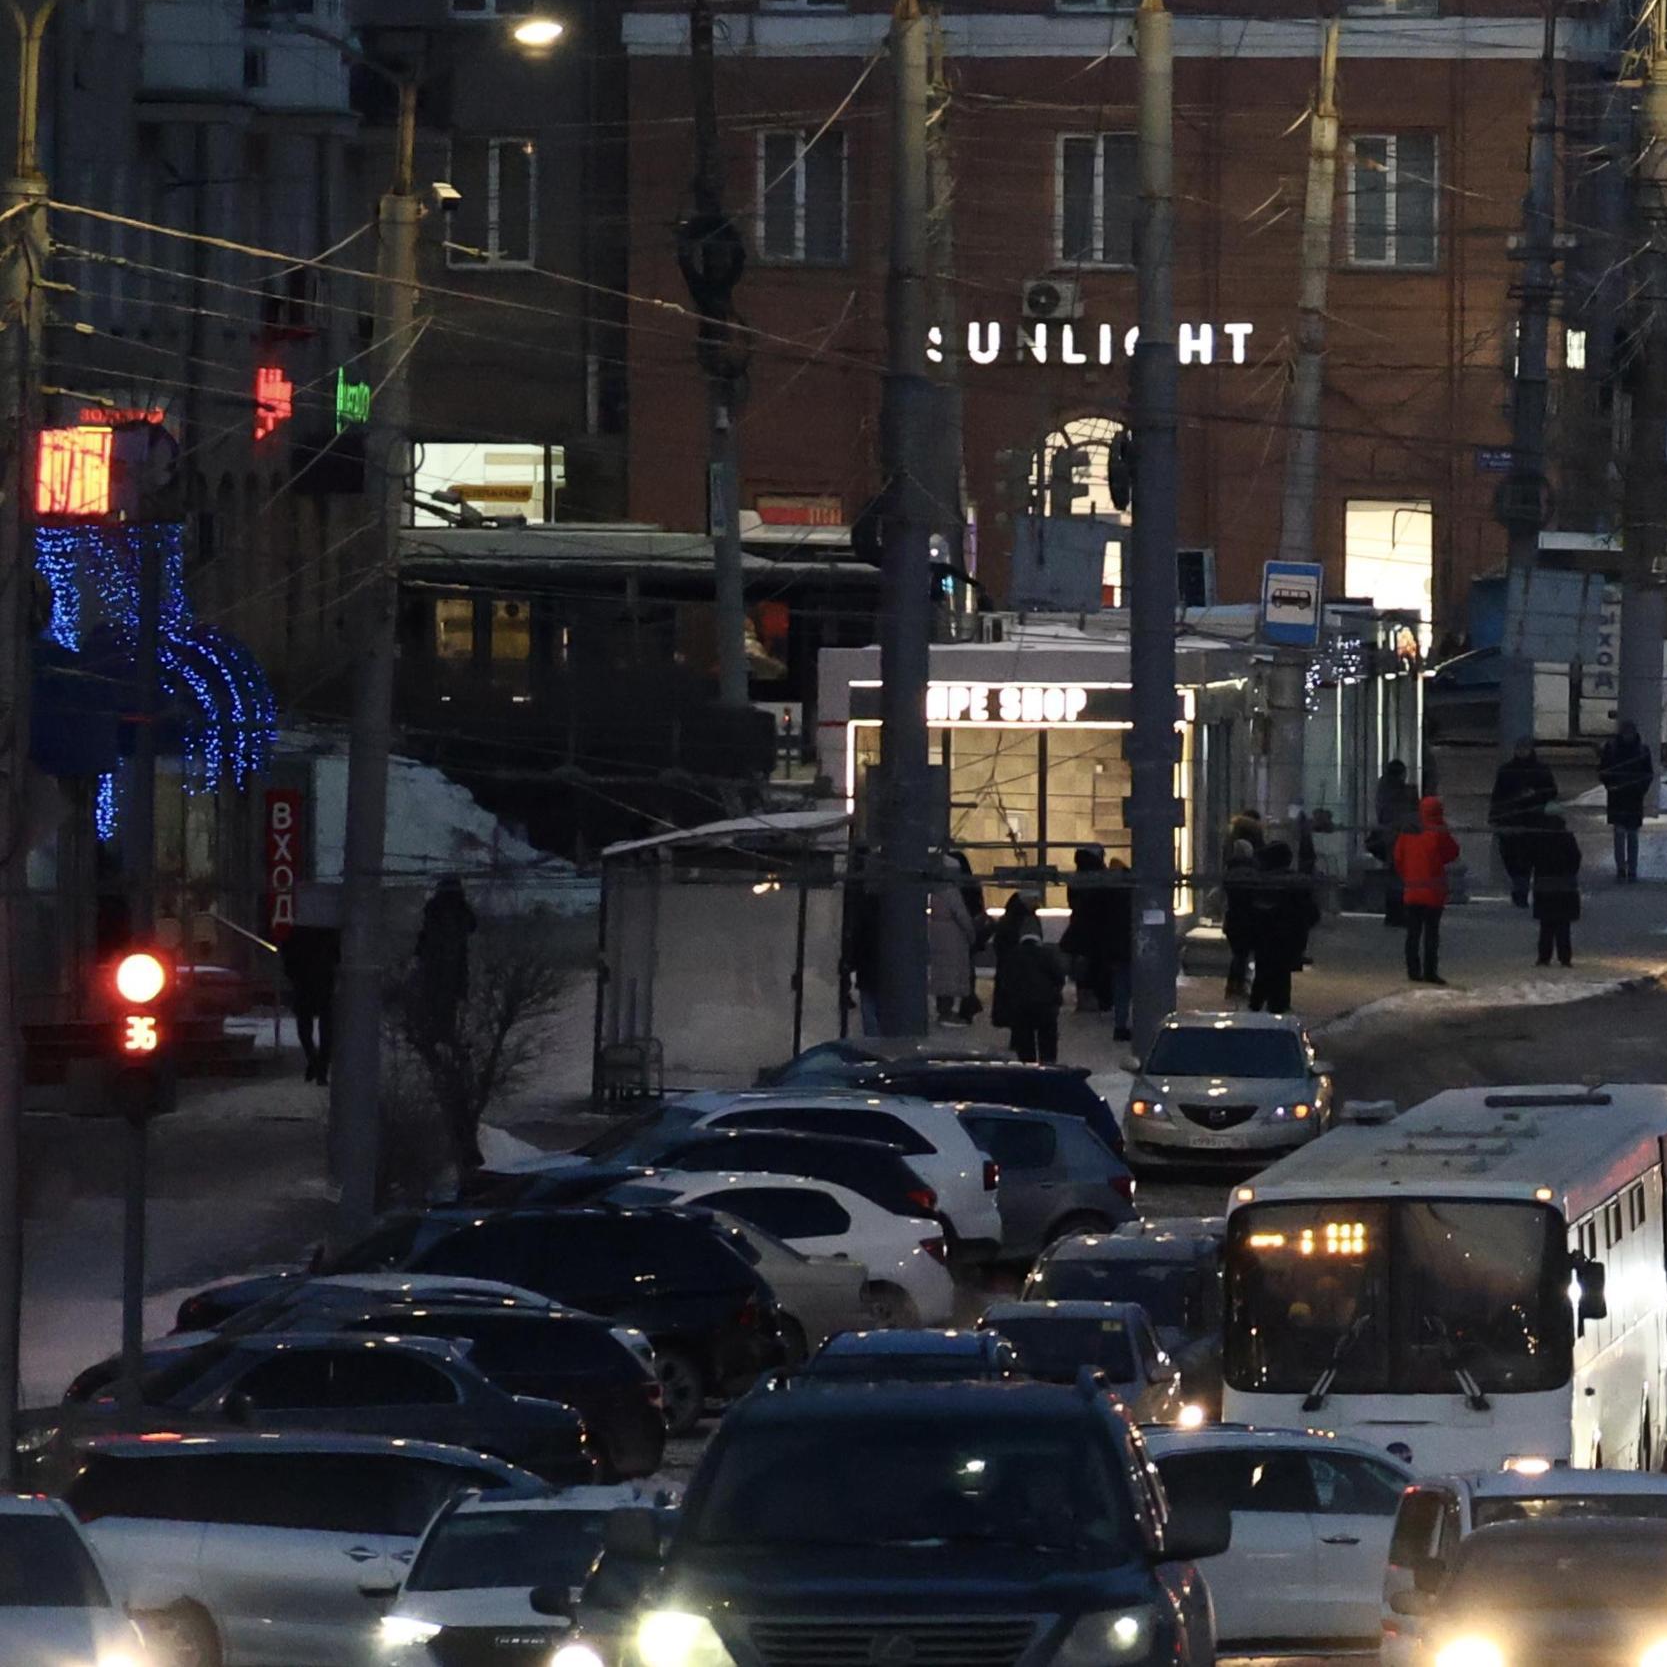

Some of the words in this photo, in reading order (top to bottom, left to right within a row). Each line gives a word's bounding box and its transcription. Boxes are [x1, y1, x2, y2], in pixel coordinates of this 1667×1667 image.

[1596, 590, 1615, 691] ЫХОД
[926, 686, 989, 721] APE
[999, 686, 1087, 722] SHOP
[271, 801, 295, 930] ВХОД
[125, 1016, 157, 1050] 36
